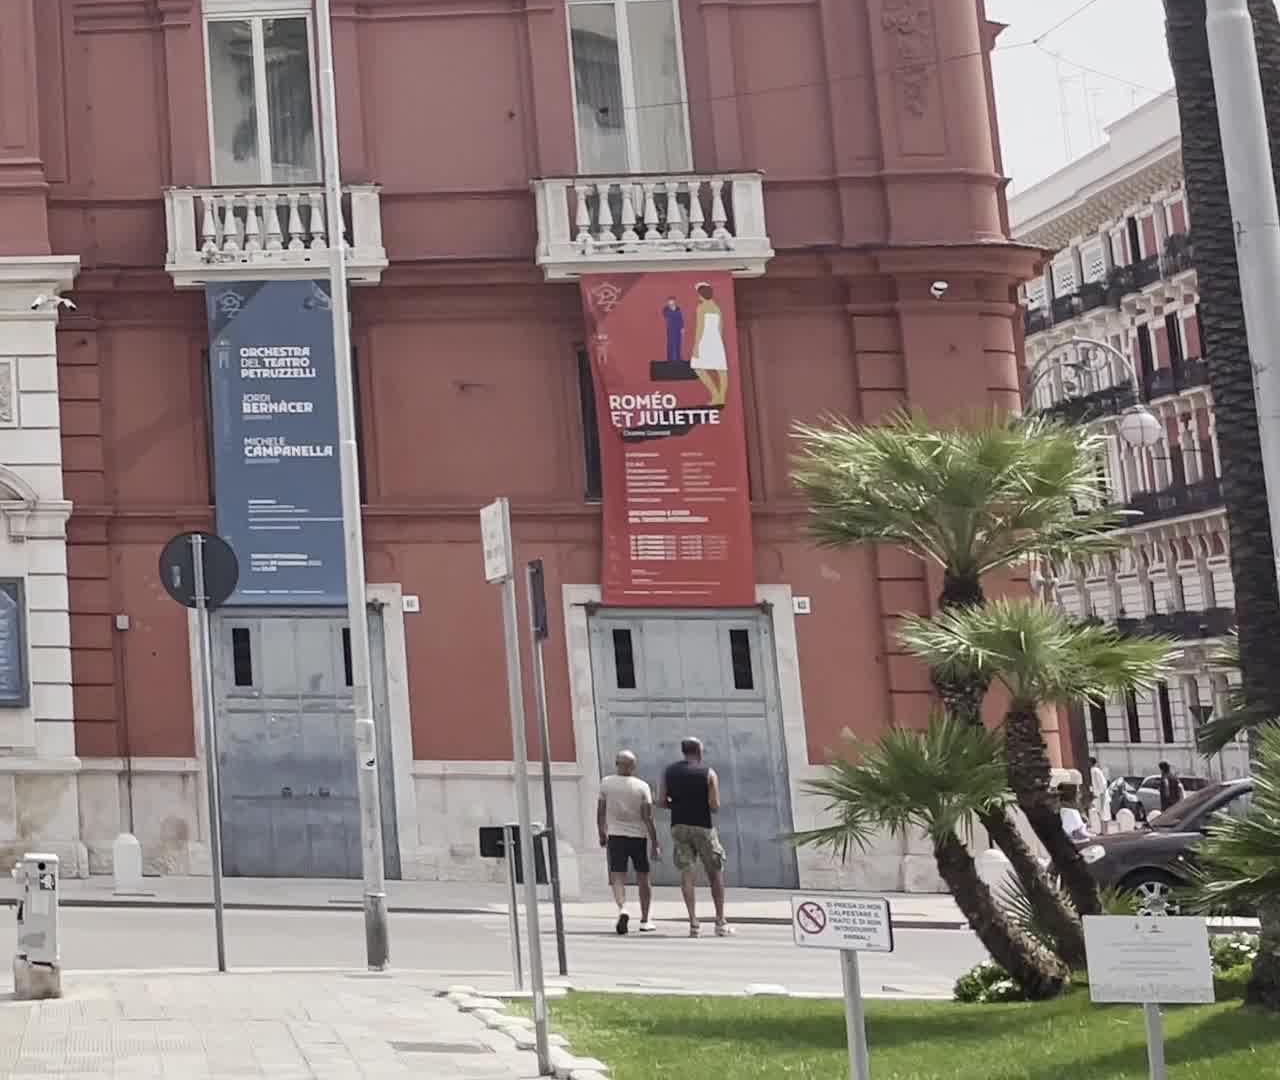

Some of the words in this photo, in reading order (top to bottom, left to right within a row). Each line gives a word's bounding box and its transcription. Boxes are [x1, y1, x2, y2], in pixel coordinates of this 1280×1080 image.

[240, 347, 310, 357] ORCHESTRA
[240, 358, 261, 368] DEL
[263, 357, 310, 367] TEATRO
[240, 368, 316, 378] PETRUZZELLI
[609, 391, 677, 410] ROMÉO
[611, 411, 635, 428] ET
[638, 410, 721, 426] JULIETTE
[244, 446, 333, 457] CAMPANELLA
